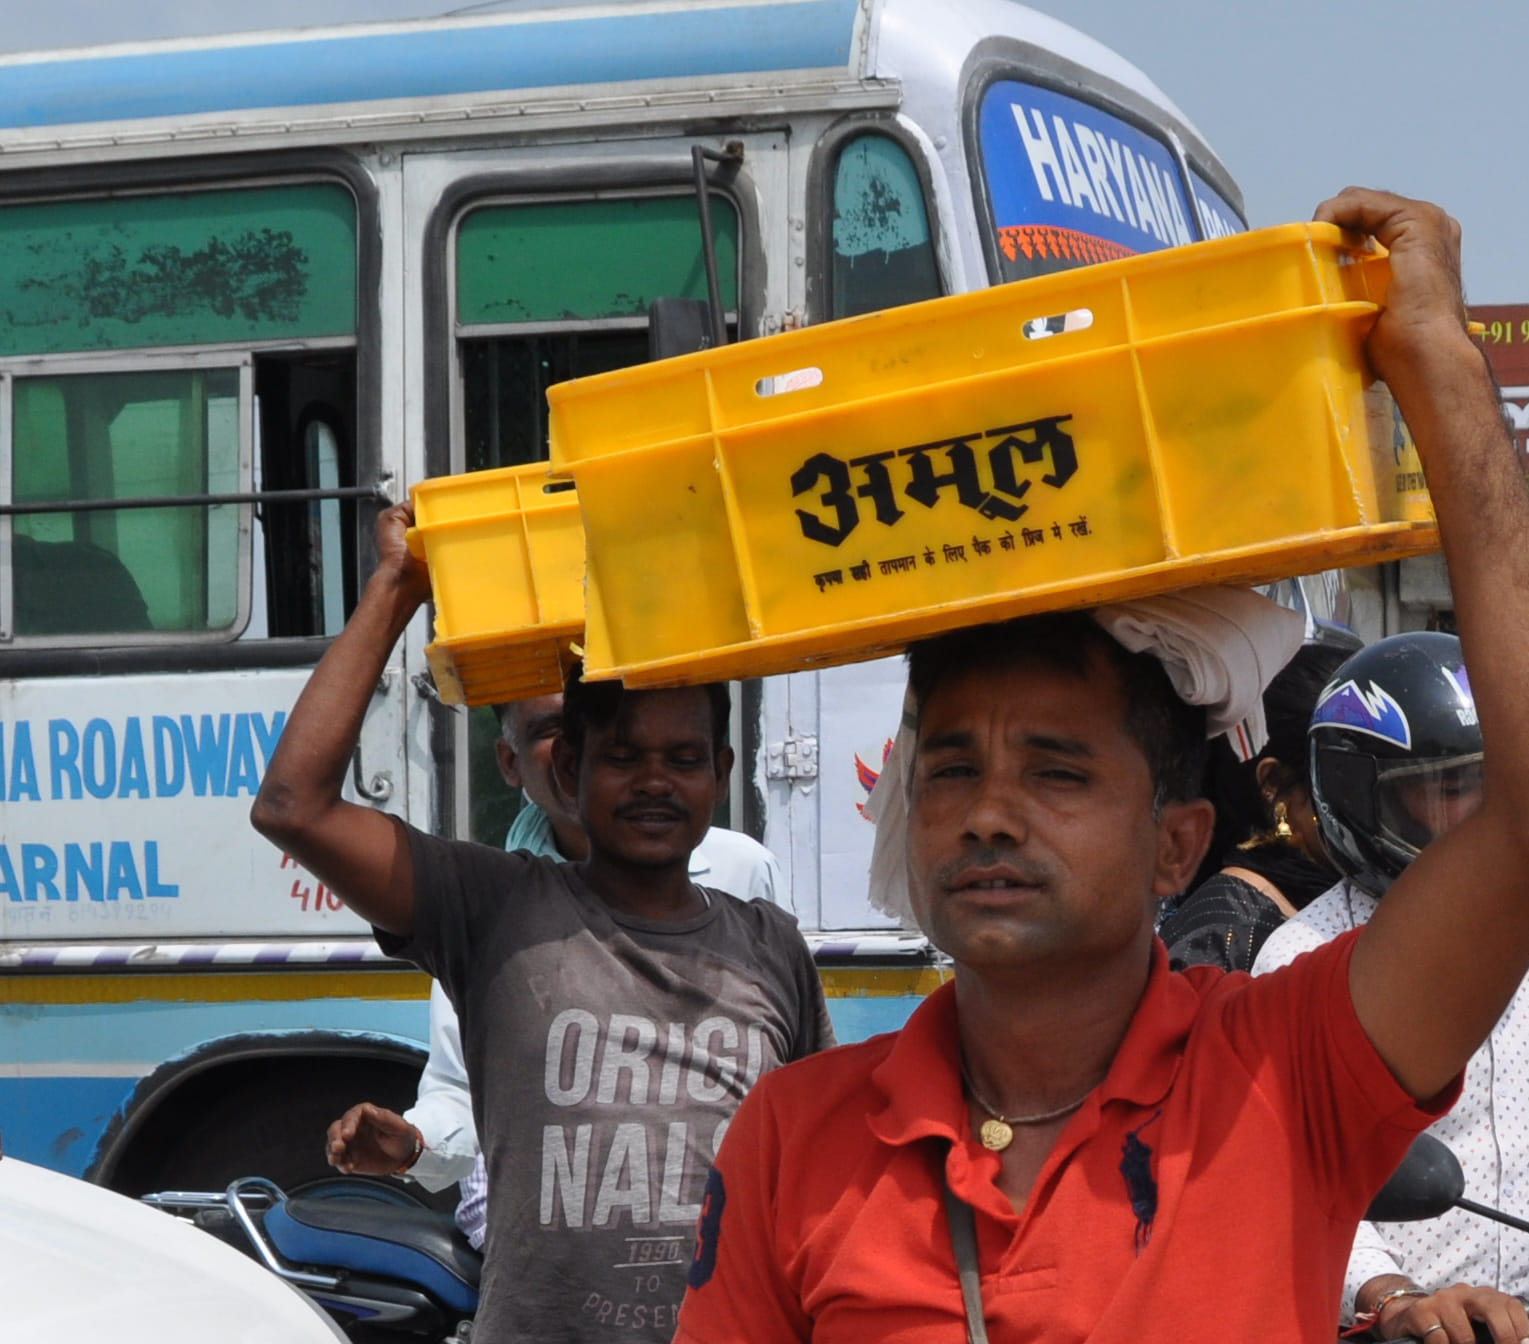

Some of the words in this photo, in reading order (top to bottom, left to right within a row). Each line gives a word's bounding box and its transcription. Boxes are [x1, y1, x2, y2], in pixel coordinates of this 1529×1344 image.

[1010, 102, 1192, 248] HARYANA
[878, 555, 917, 576] तापमान
[922, 546, 936, 566] के
[999, 531, 1016, 551] को
[540, 1120, 731, 1228] NAL
[634, 1275, 661, 1293] TO
